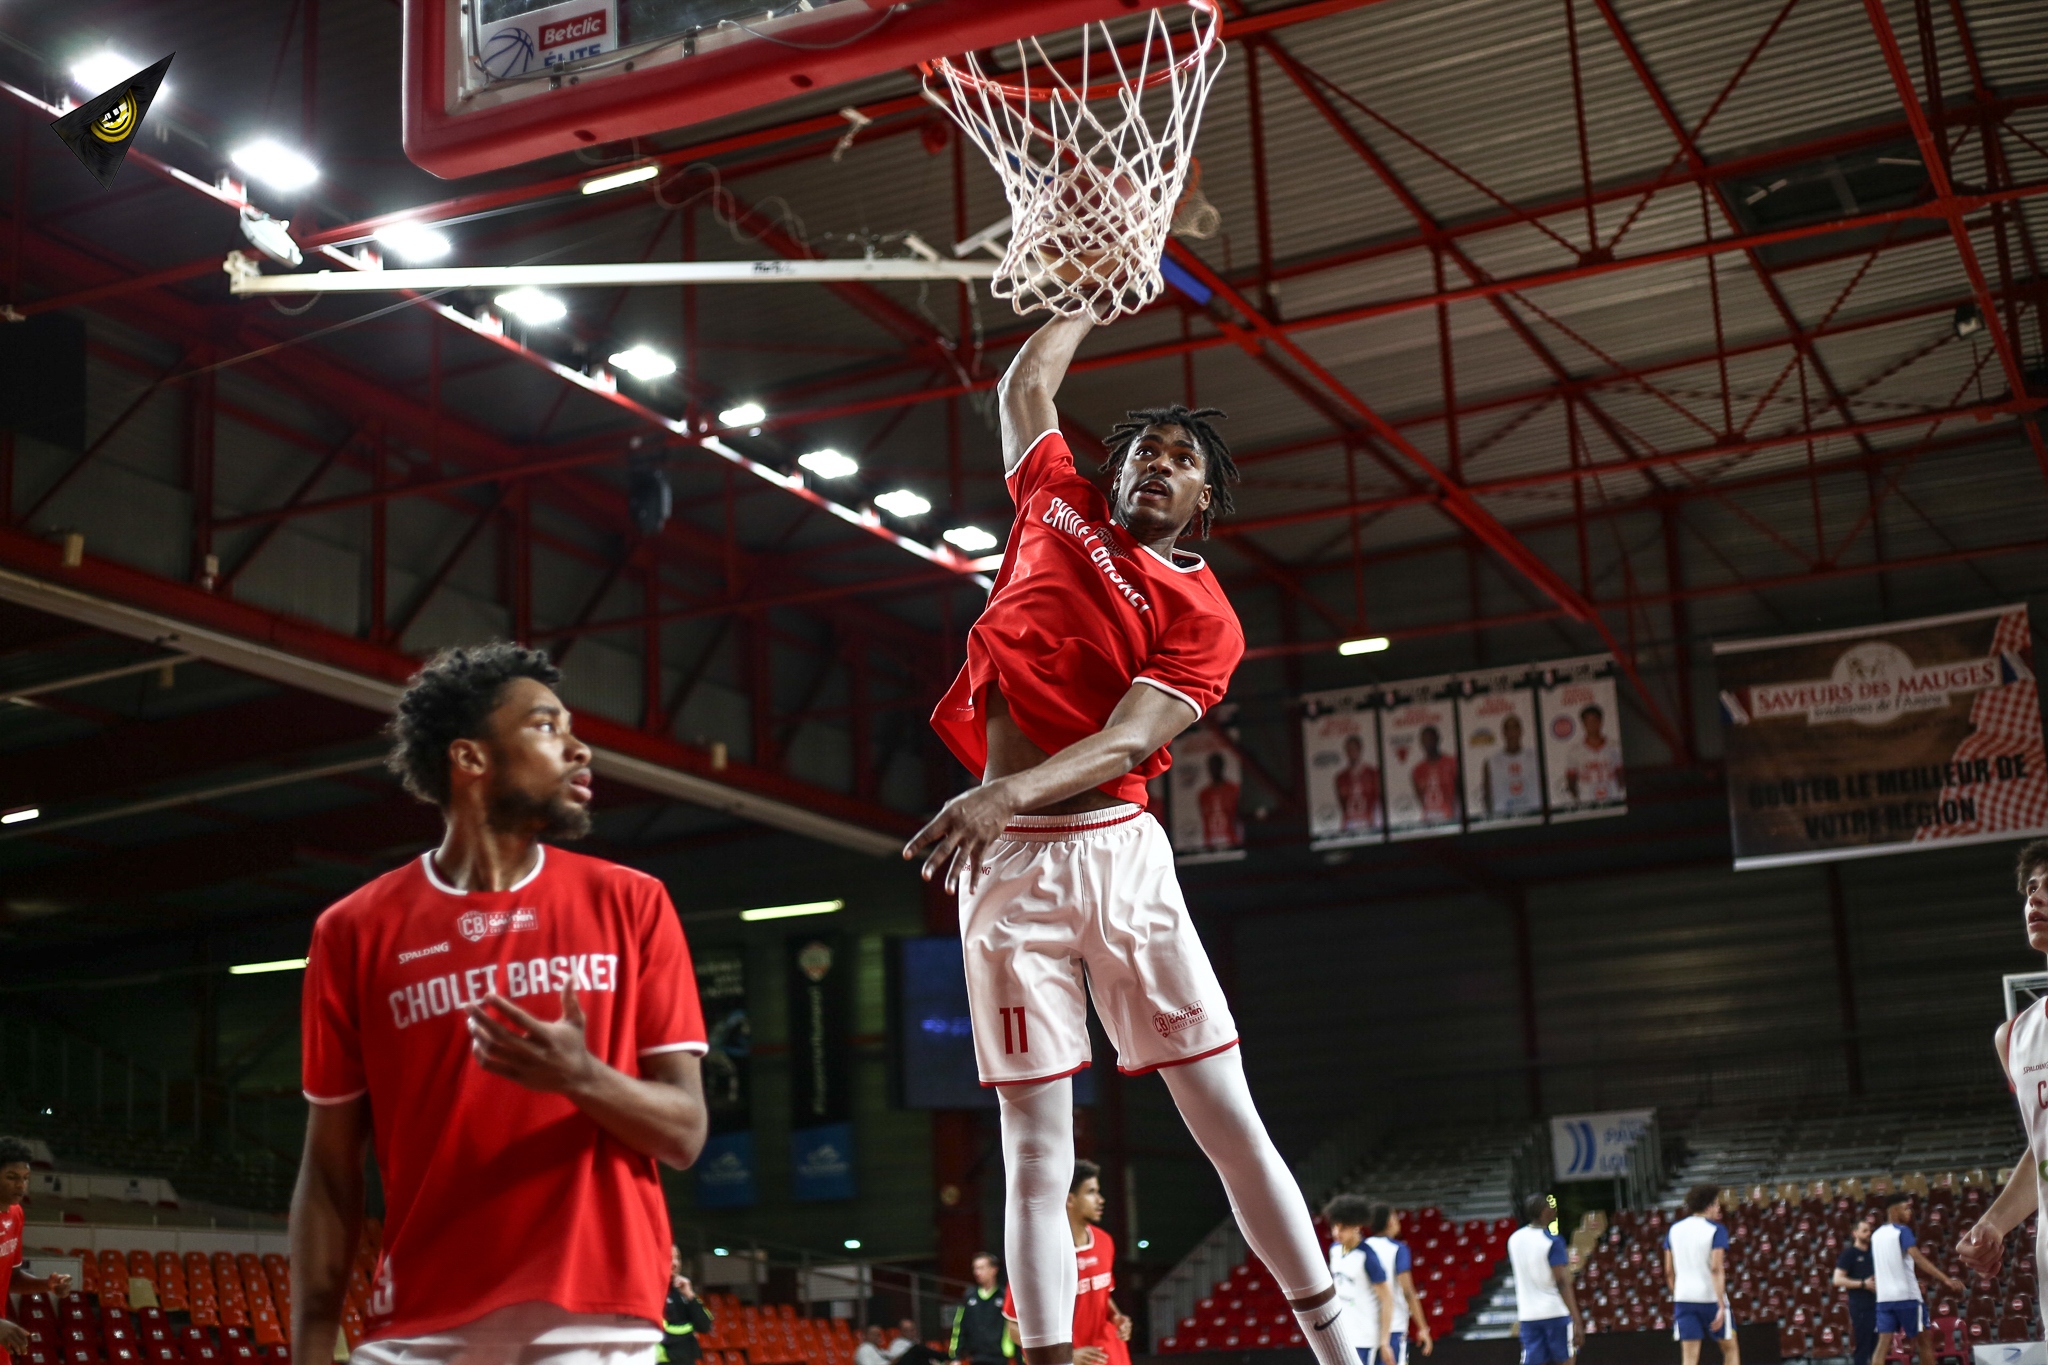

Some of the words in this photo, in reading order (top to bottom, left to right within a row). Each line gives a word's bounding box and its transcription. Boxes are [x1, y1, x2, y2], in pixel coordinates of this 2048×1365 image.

[544, 17, 601, 45] Betclic
[1758, 683, 1853, 711] SAVEURS
[1859, 681, 1891, 700] DES
[1898, 661, 1994, 694] MAUGES
[1847, 771, 1871, 799] LE
[1878, 759, 1990, 796] MEILLEUR
[1995, 753, 2028, 781] DE
[1804, 807, 1880, 840] VOTRE
[462, 916, 485, 936] CB
[399, 942, 449, 964] SPALDING
[389, 964, 498, 1029] CHOLET
[507, 954, 618, 998] BASKET
[999, 1006, 1028, 1055] 11
[1154, 1016, 1168, 1033] CB
